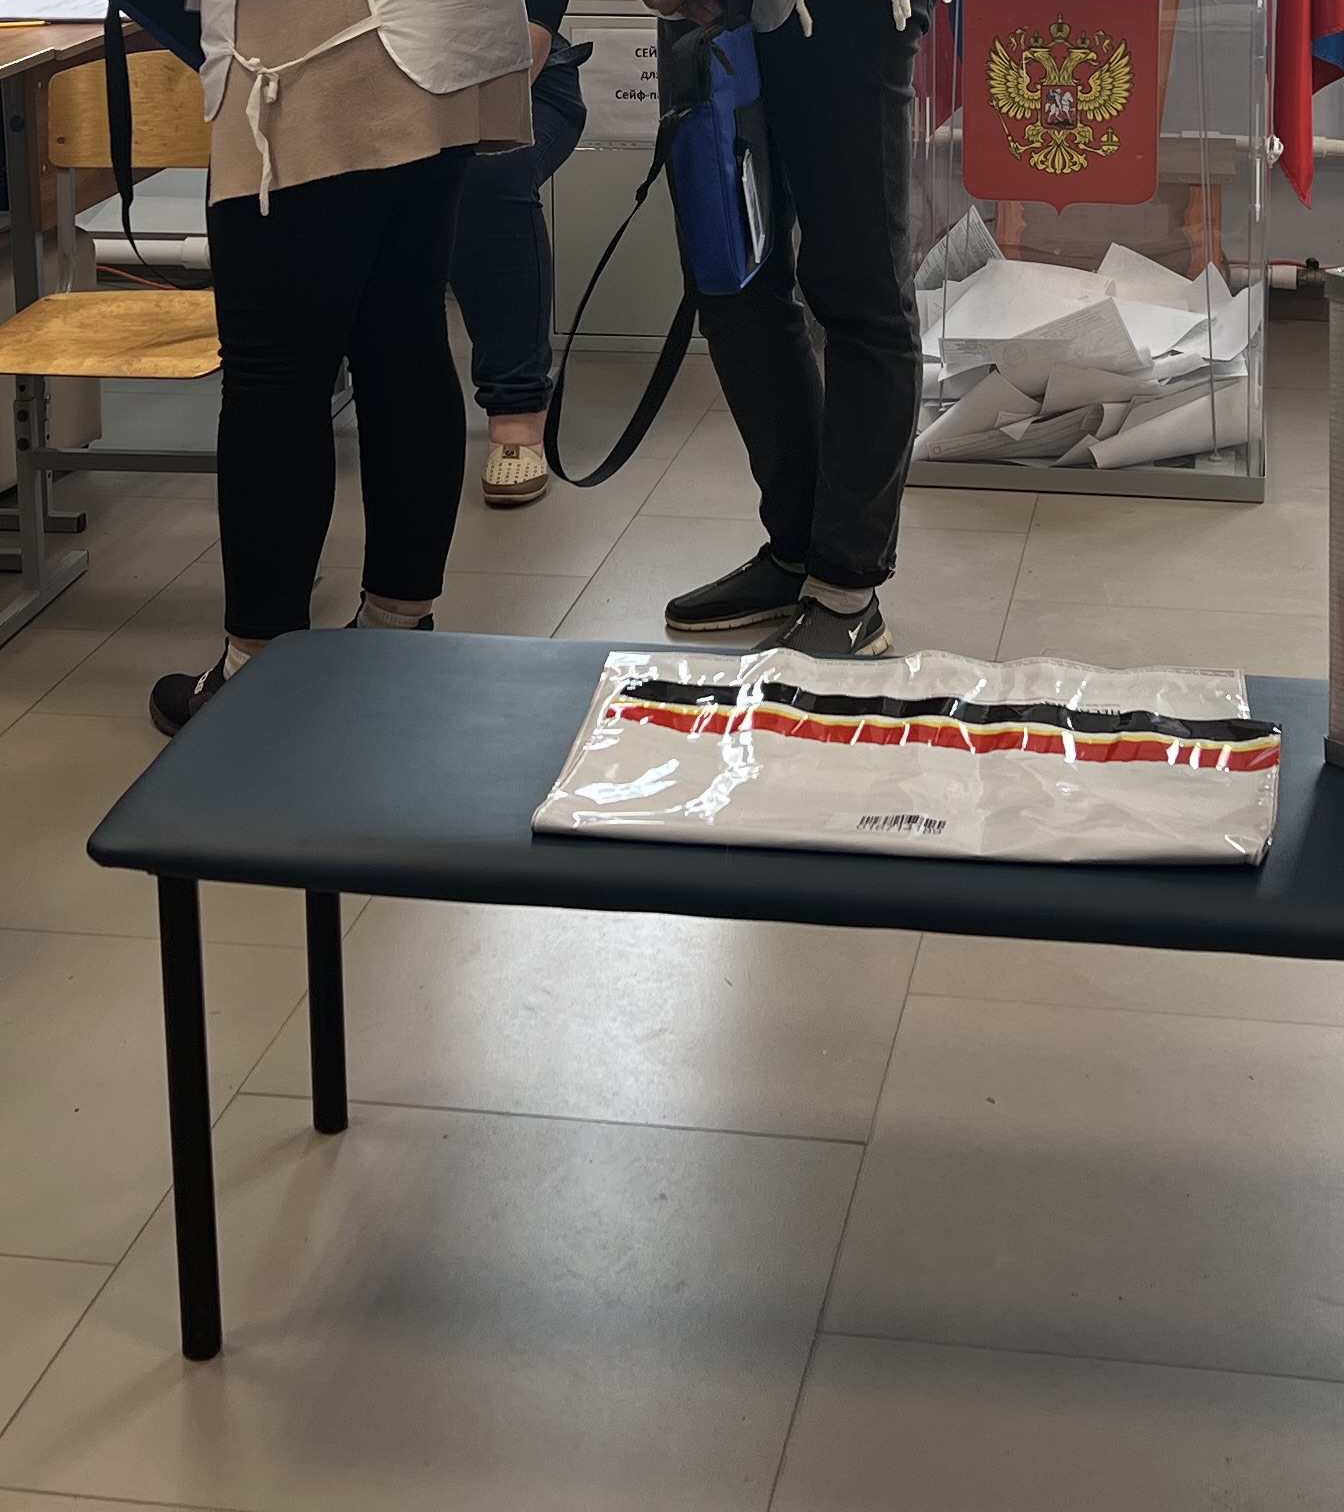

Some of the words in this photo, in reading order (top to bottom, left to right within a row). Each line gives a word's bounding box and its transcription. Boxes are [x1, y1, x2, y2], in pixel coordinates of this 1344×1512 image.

[635, 46, 657, 58] СЕЙ
[641, 71, 658, 81] дл
[615, 89, 660, 102] Сейф-п
